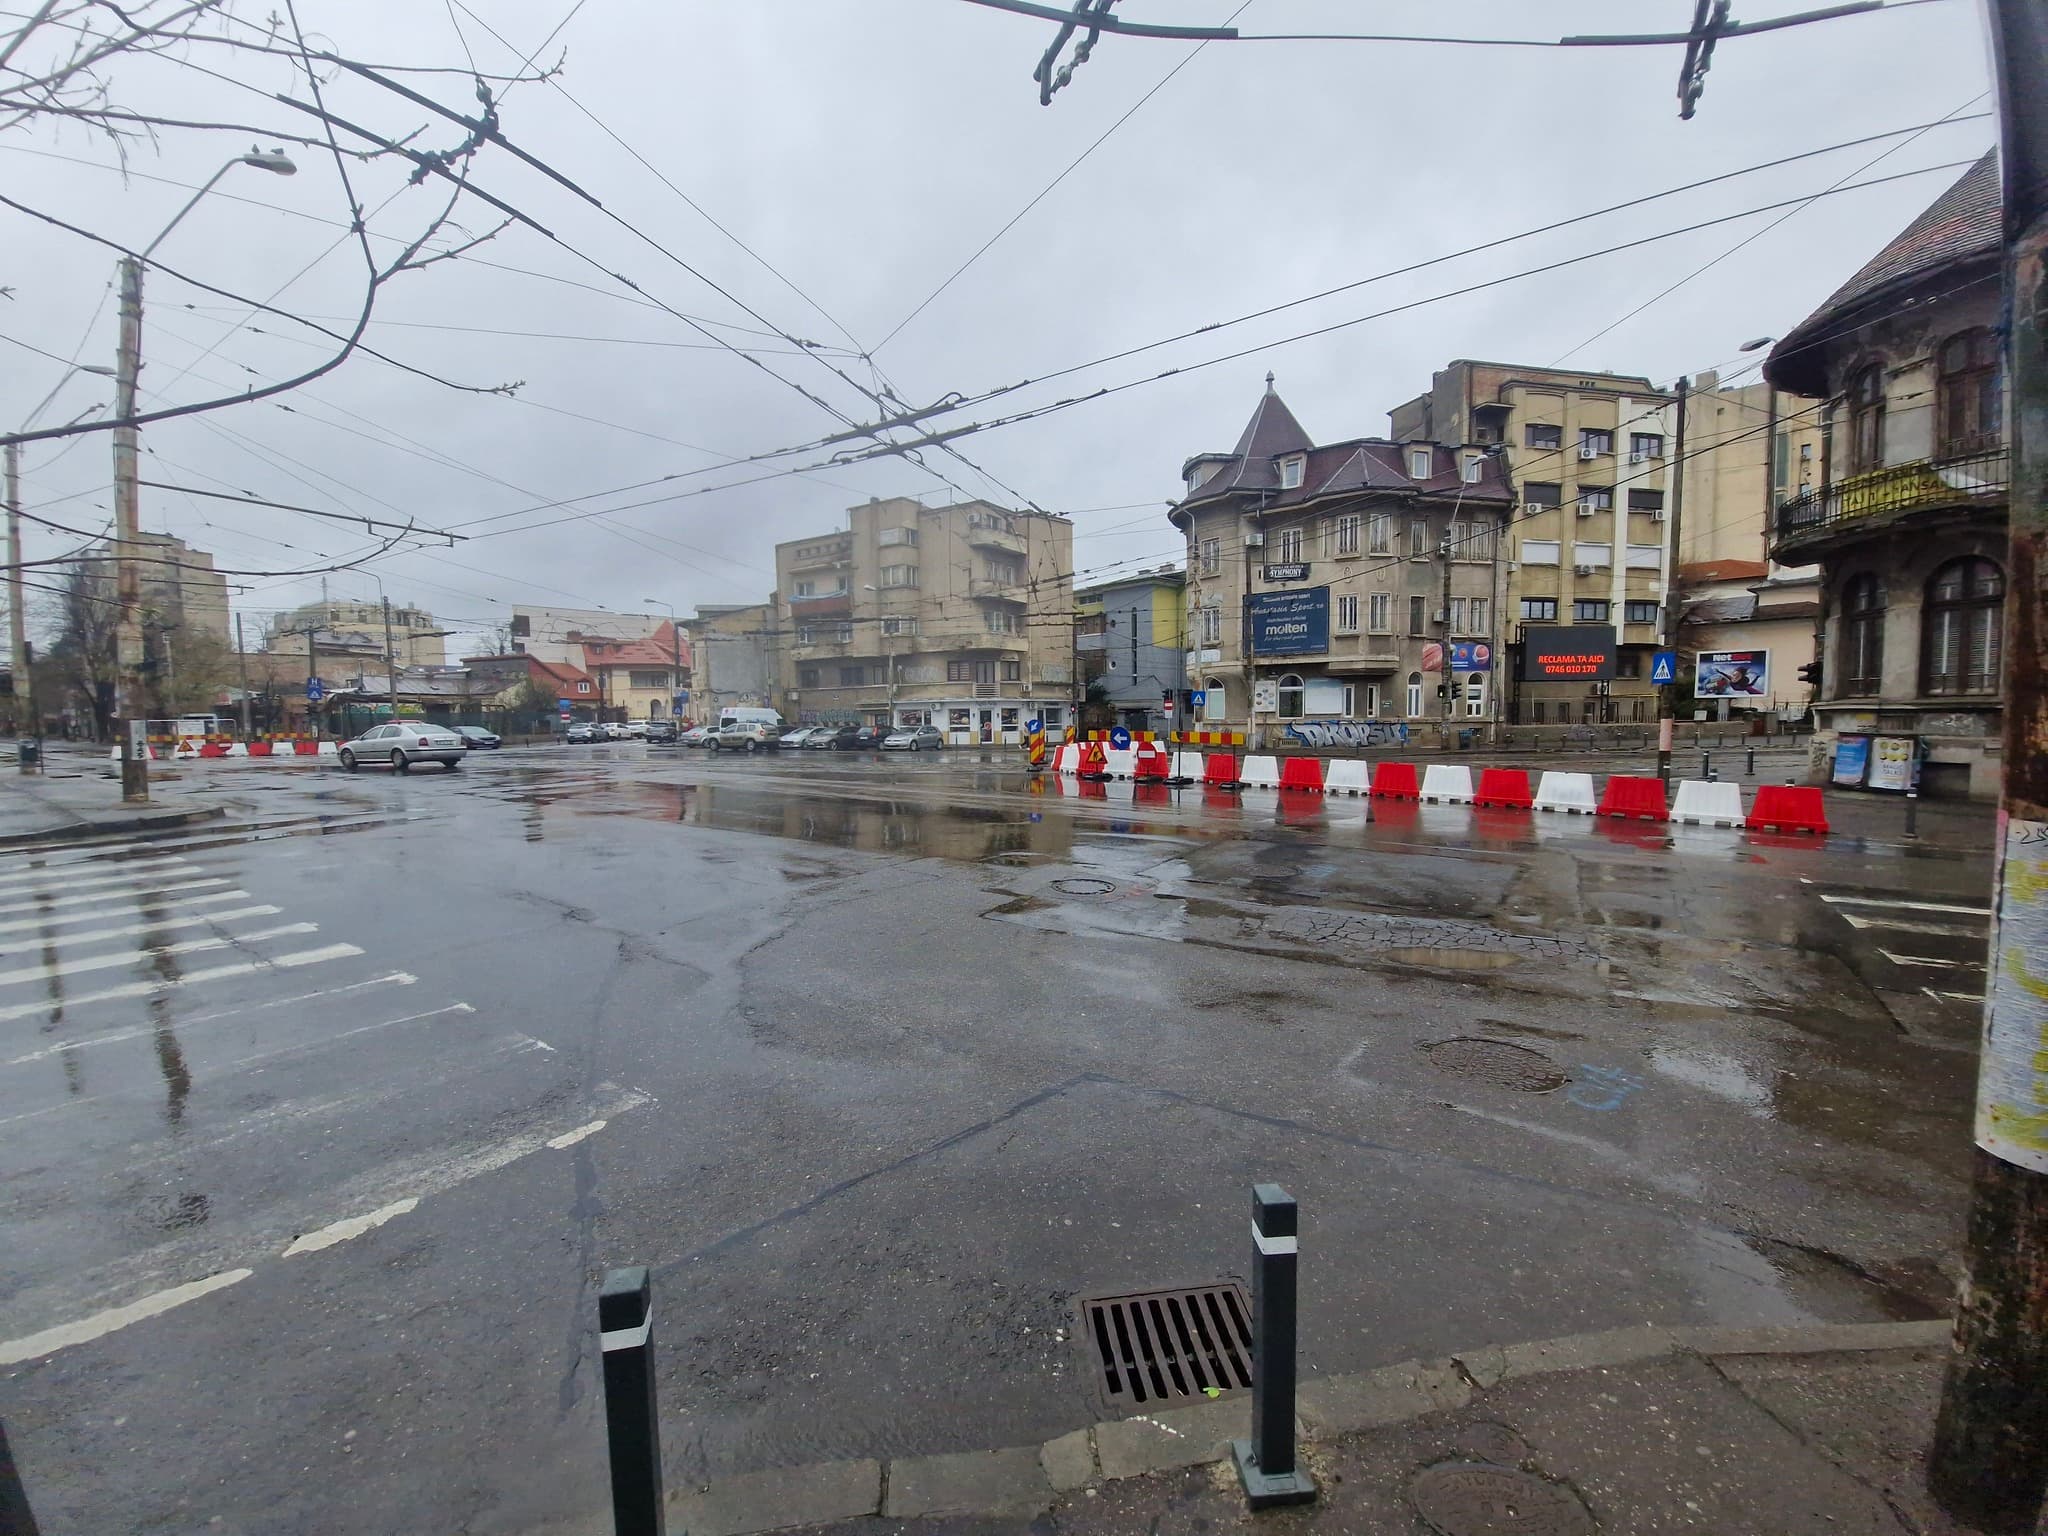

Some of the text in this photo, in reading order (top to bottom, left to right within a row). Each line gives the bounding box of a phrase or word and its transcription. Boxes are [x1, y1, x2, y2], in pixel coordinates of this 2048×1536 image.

[1269, 568, 1302, 578] SYMPHONY
[1265, 623, 1308, 635] molten
[1538, 655, 1605, 664] RECLAMA TA AICI
[1545, 665, 1597, 673] 0746 010 170
